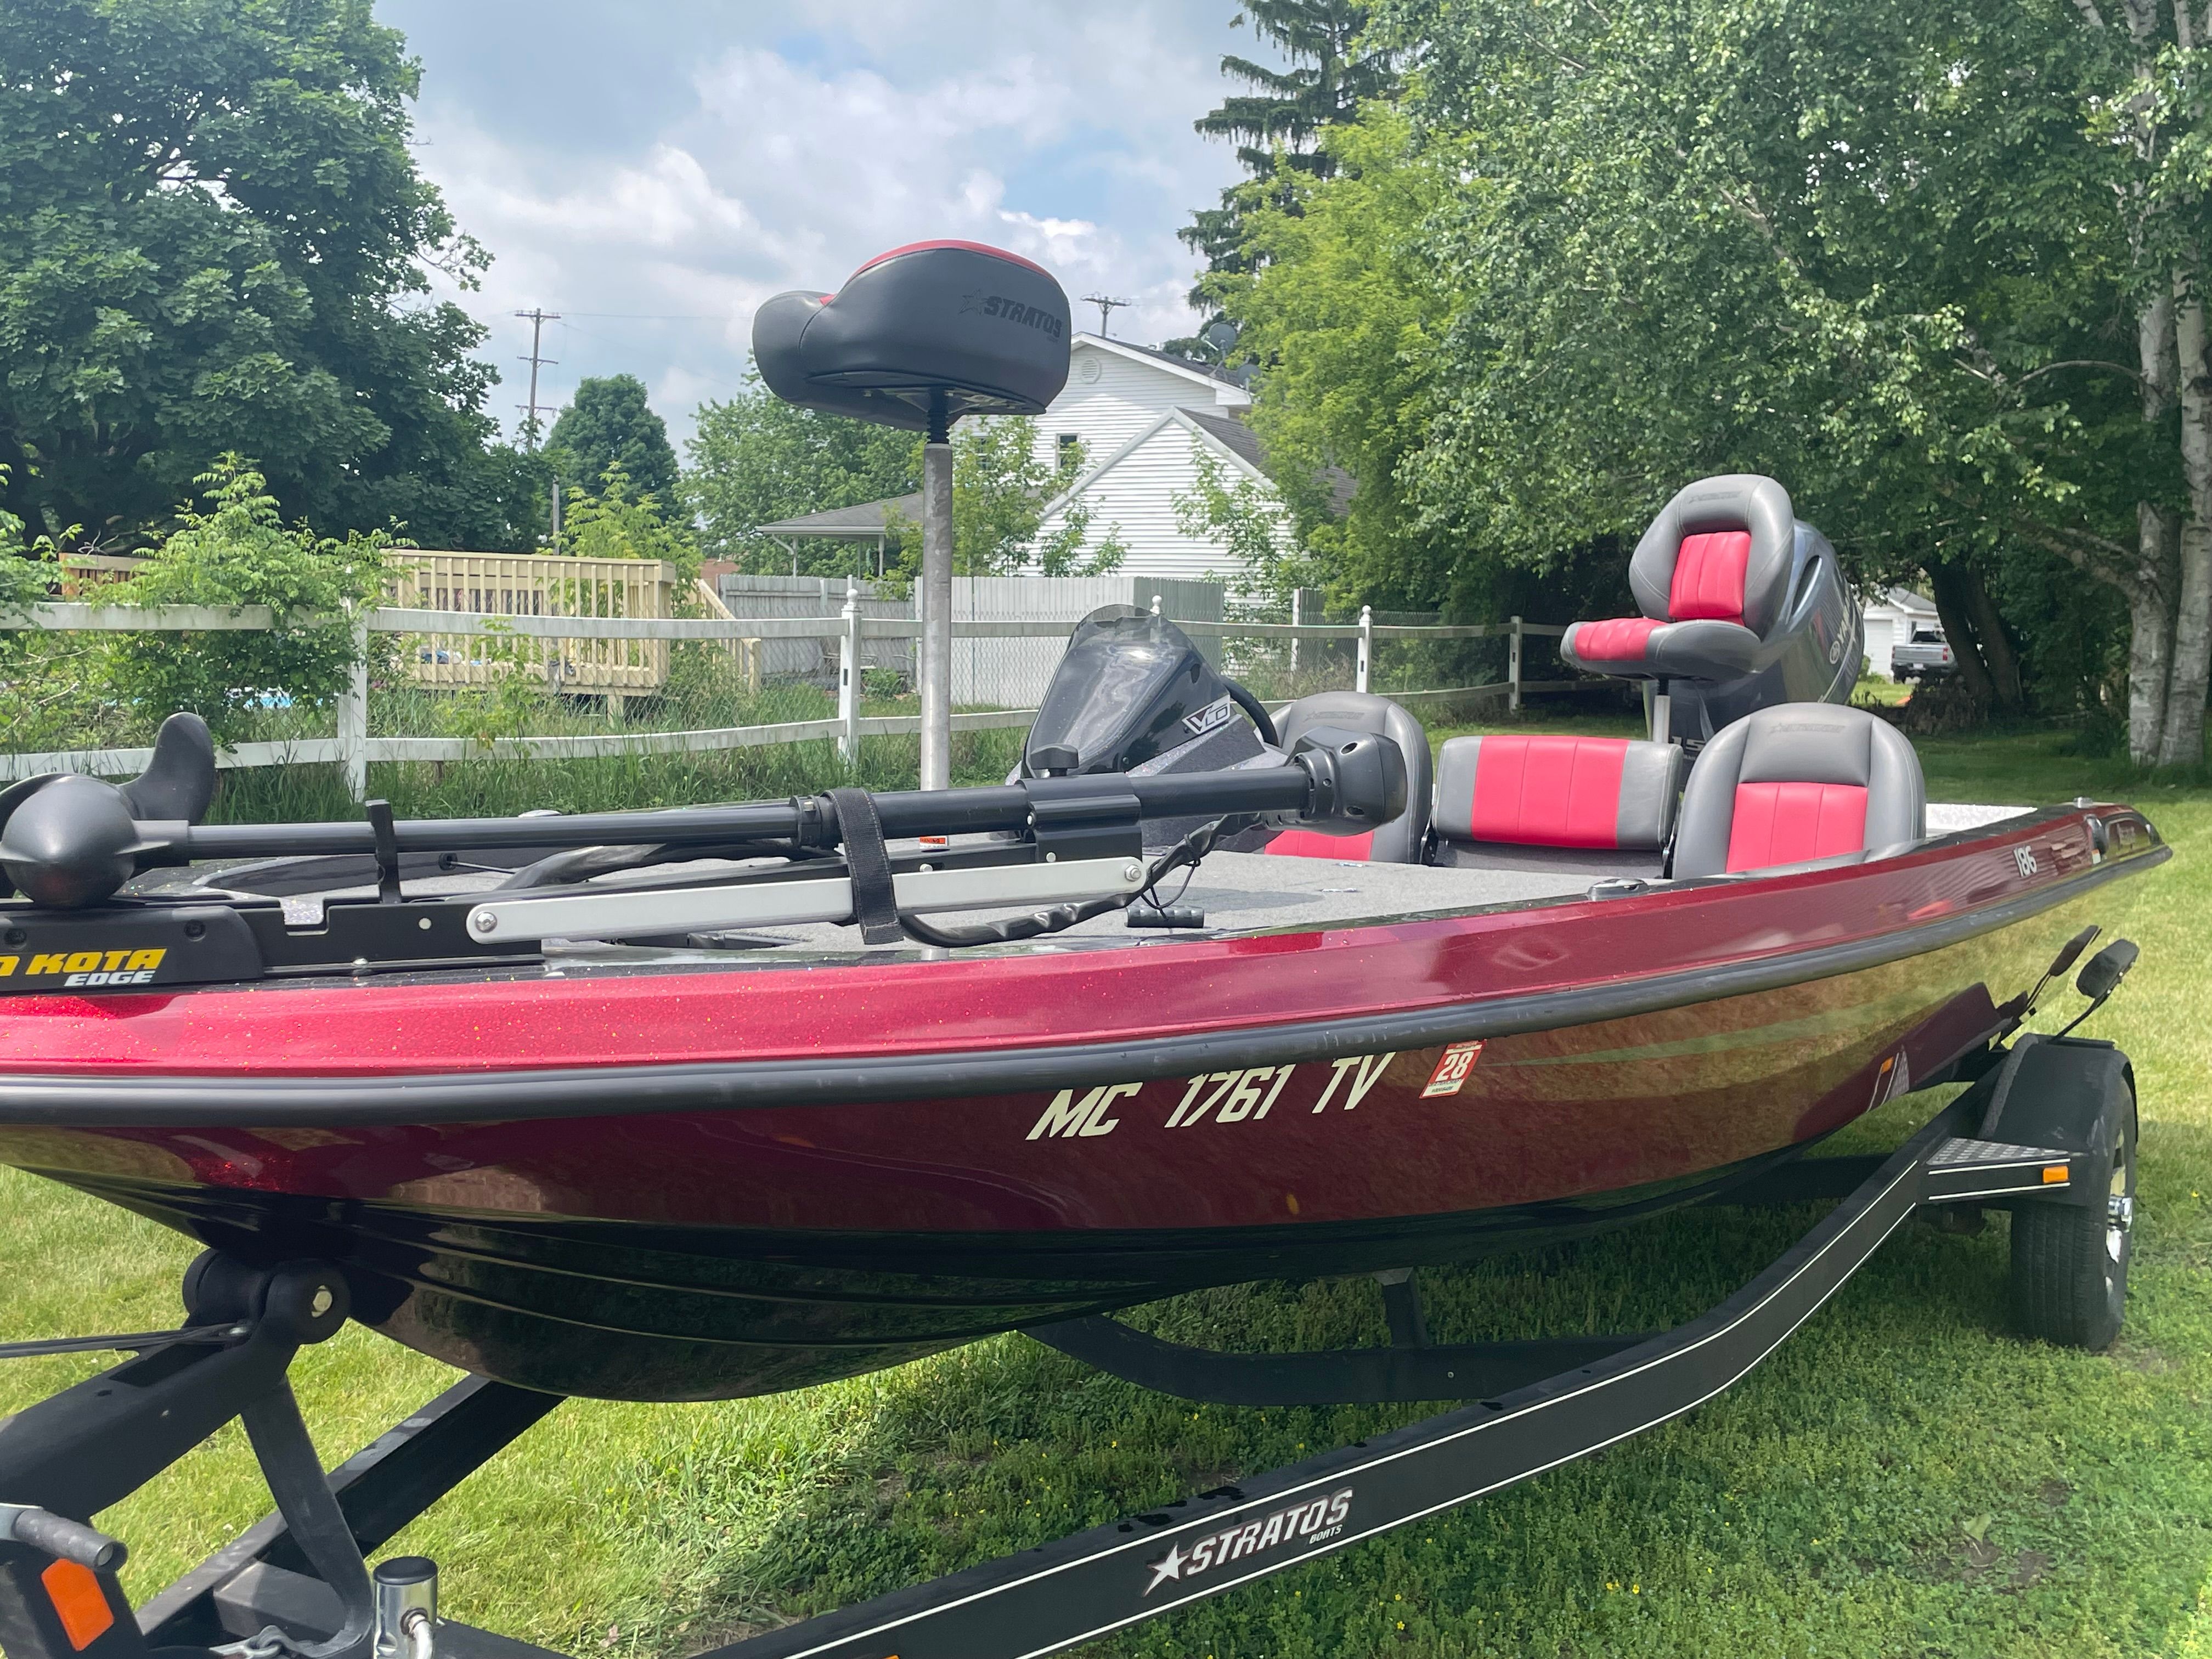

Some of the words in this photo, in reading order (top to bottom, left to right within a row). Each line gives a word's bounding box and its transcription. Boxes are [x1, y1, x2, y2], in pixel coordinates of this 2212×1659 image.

[984, 296, 1063, 338] STRATOS
[2013, 845, 2037, 878] 186
[25, 949, 167, 975] KOTA
[64, 970, 156, 987] EDGE
[1435, 1051, 1475, 1082] 28
[1025, 1082, 1143, 1141] MC
[1164, 1064, 1296, 1128] 1761
[1312, 1051, 1396, 1114] TV
[1187, 1488, 1353, 1576] STRATOS
[1309, 1523, 1343, 1545] BOATS
